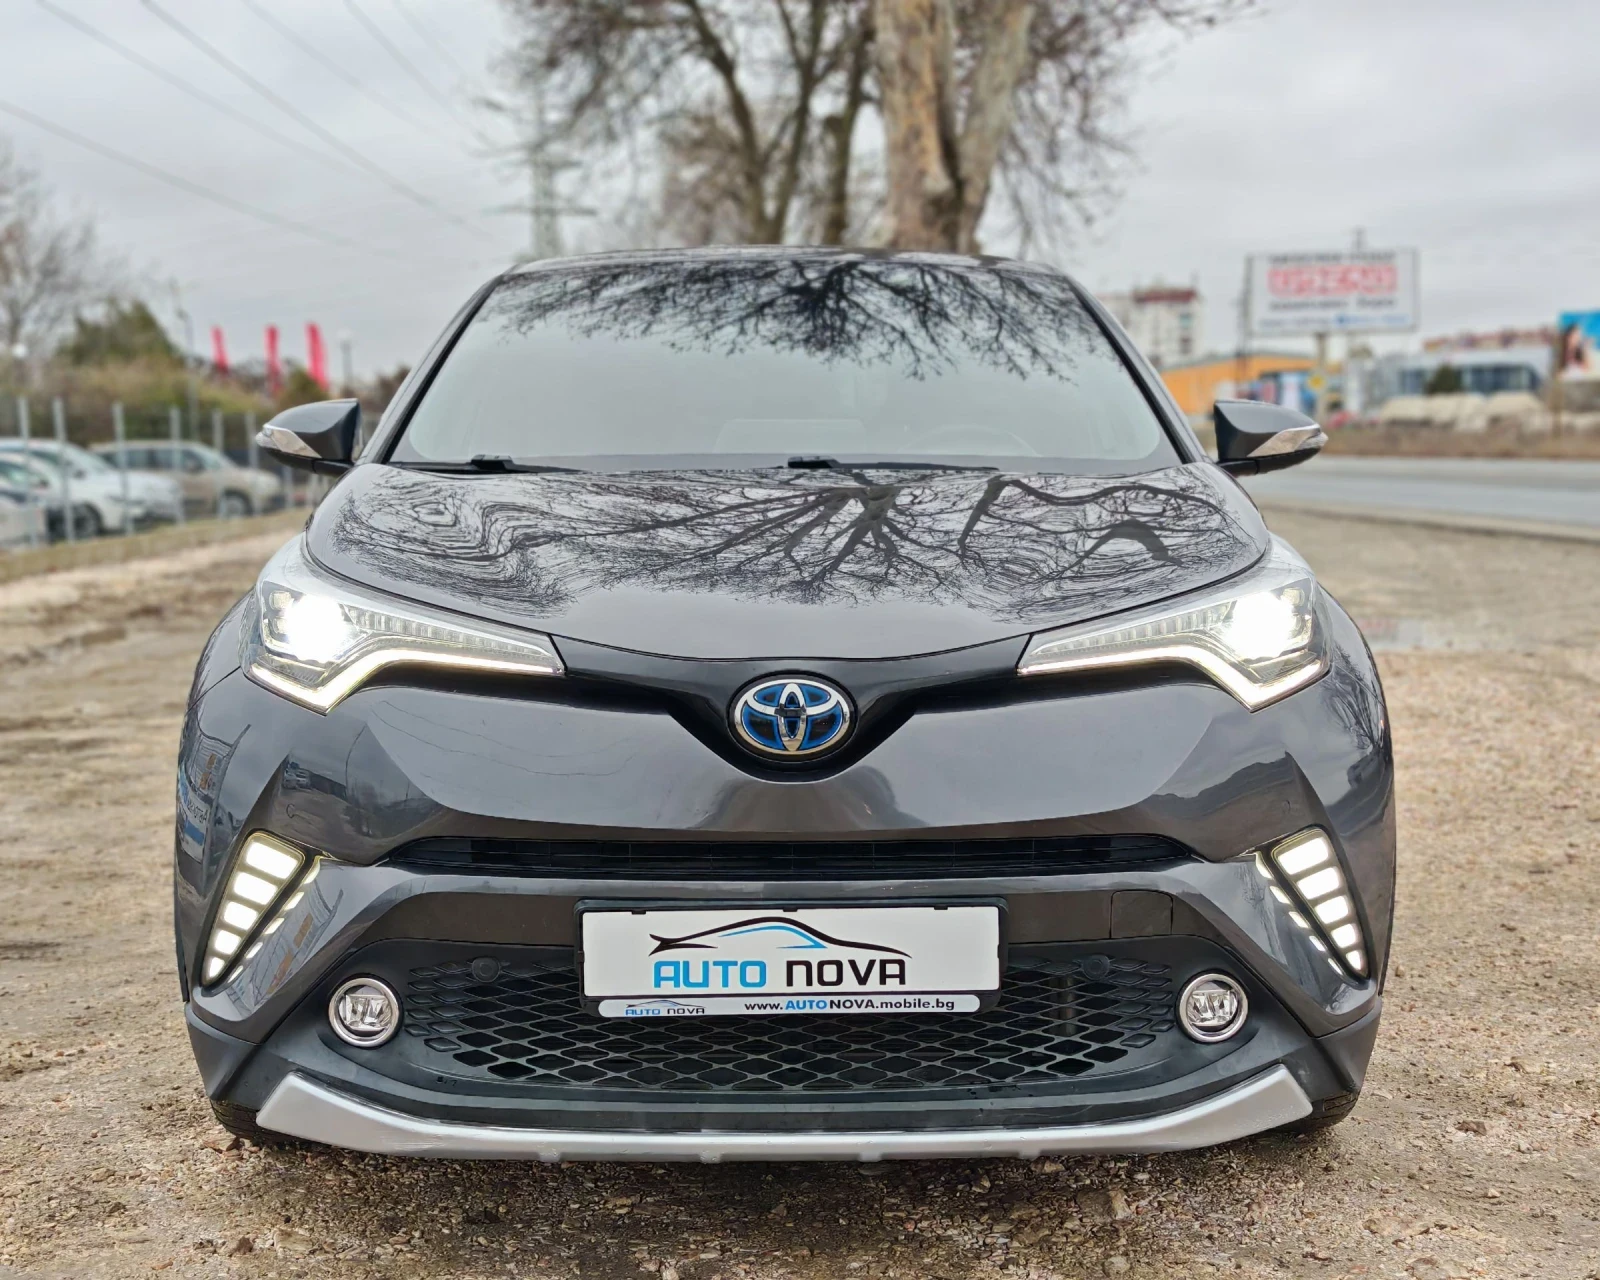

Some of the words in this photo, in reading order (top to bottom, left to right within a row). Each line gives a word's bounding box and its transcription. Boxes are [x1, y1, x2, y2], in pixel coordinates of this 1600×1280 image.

[653, 960, 767, 988] AUTO
[786, 958, 906, 987] NOVA
[744, 998, 955, 1011] www.AUTONOVA.mobile.bg
[625, 1008, 661, 1016] AUTO
[667, 1007, 705, 1015] NOVA
